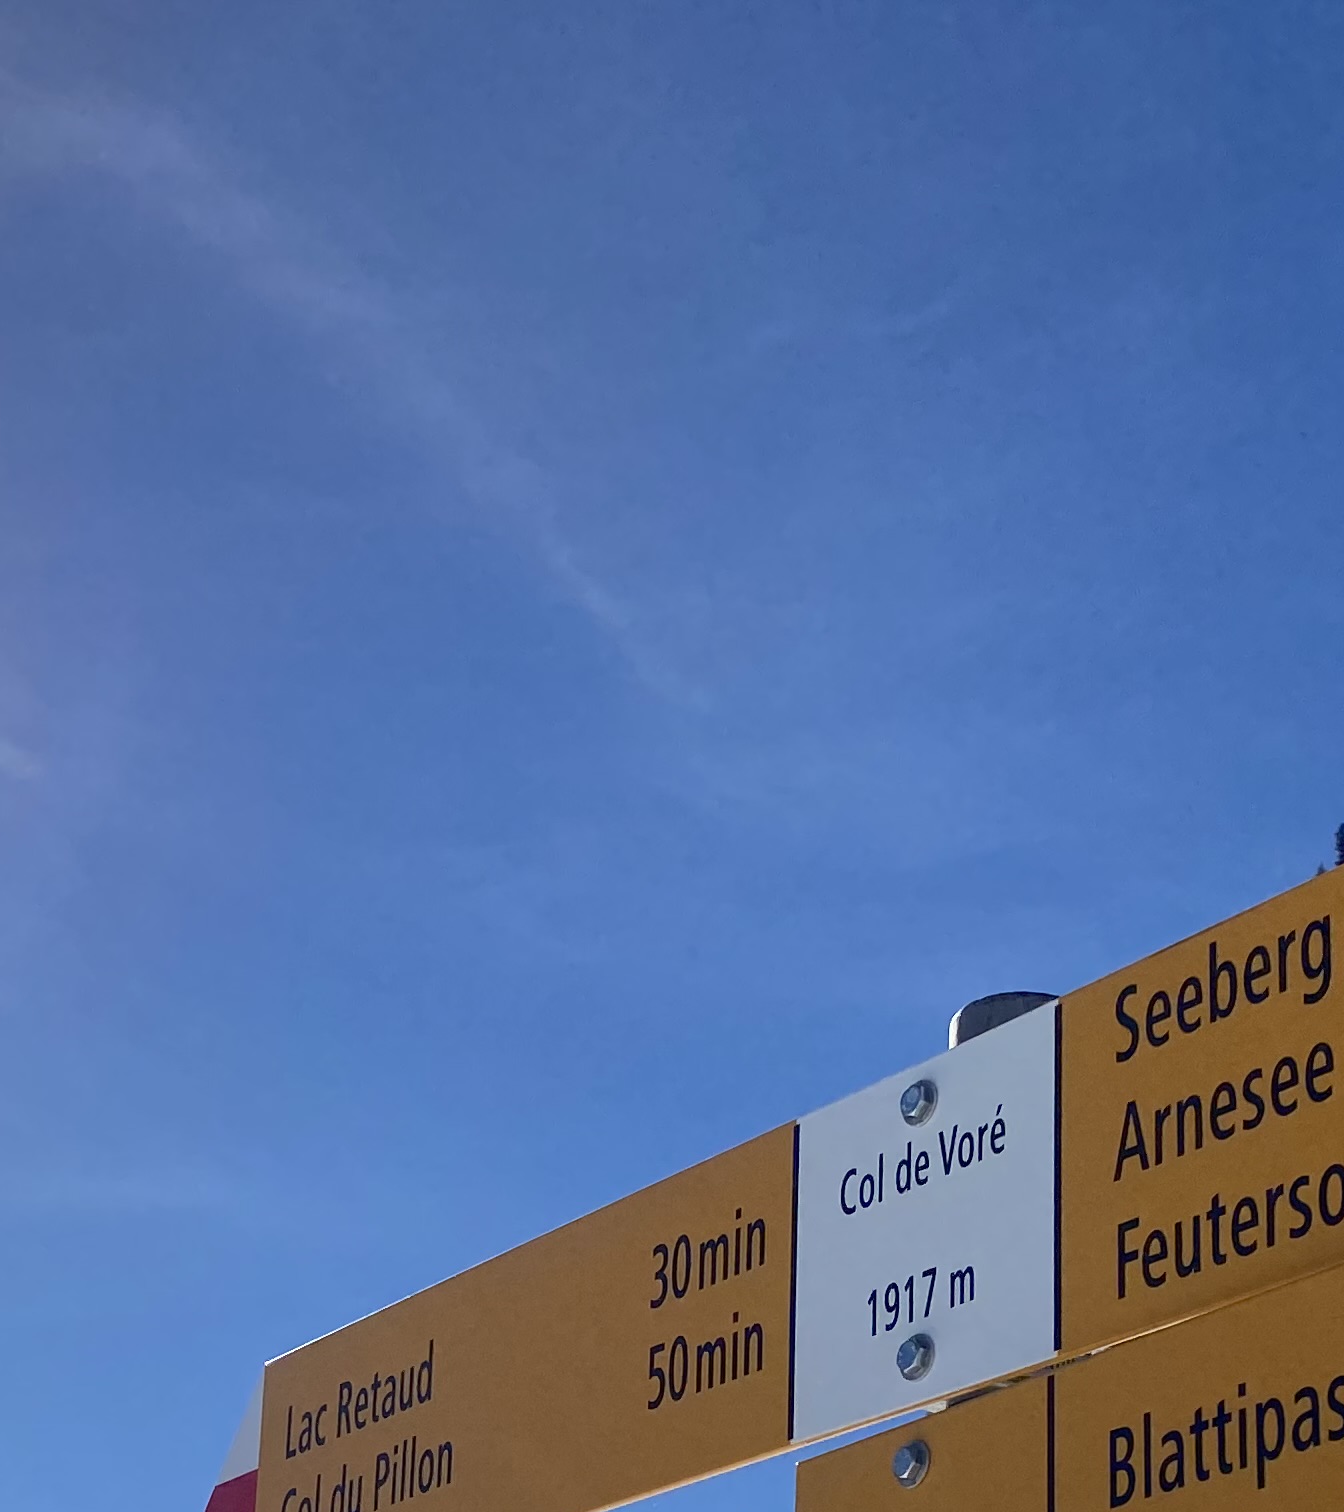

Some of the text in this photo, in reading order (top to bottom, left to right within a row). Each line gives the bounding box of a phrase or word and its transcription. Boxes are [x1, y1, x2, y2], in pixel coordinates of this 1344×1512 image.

[1113, 913, 1333, 1065] Seeberg
[840, 1104, 1007, 1217] Col de Voré
[1112, 1041, 1336, 1184] Arnesee
[866, 1264, 976, 1338] 1917 m
[285, 1402, 329, 1461] Lac
[335, 1338, 436, 1440] Retaud
